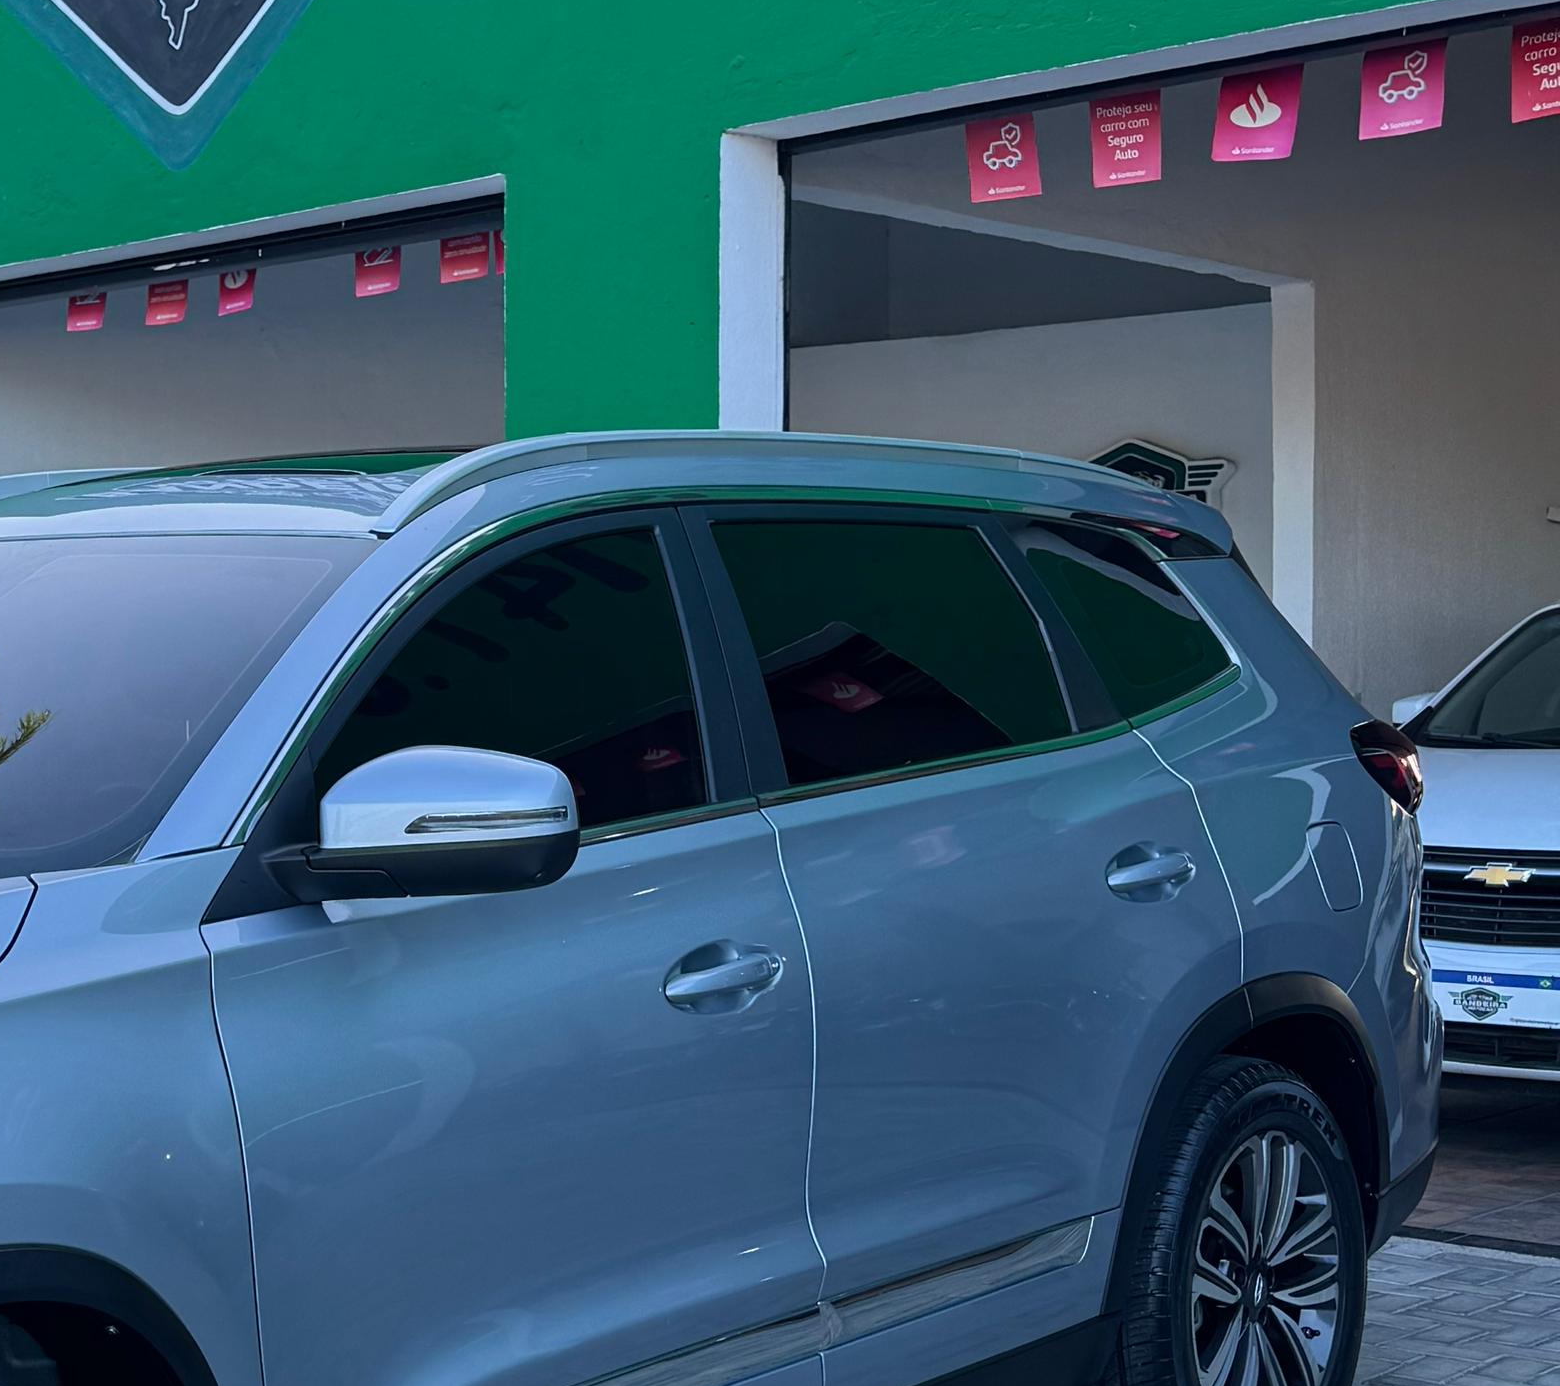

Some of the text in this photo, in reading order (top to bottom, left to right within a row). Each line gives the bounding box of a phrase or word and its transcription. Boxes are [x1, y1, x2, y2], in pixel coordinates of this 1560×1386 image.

[1521, 31, 1560, 47] Protej
[1524, 47, 1557, 61] carro
[1096, 102, 1153, 119] Proteja seu
[1100, 117, 1150, 133] carro com
[1107, 133, 1144, 147] Seguro
[1114, 149, 1139, 161] Auto
[1466, 974, 1495, 984] BRASIL
